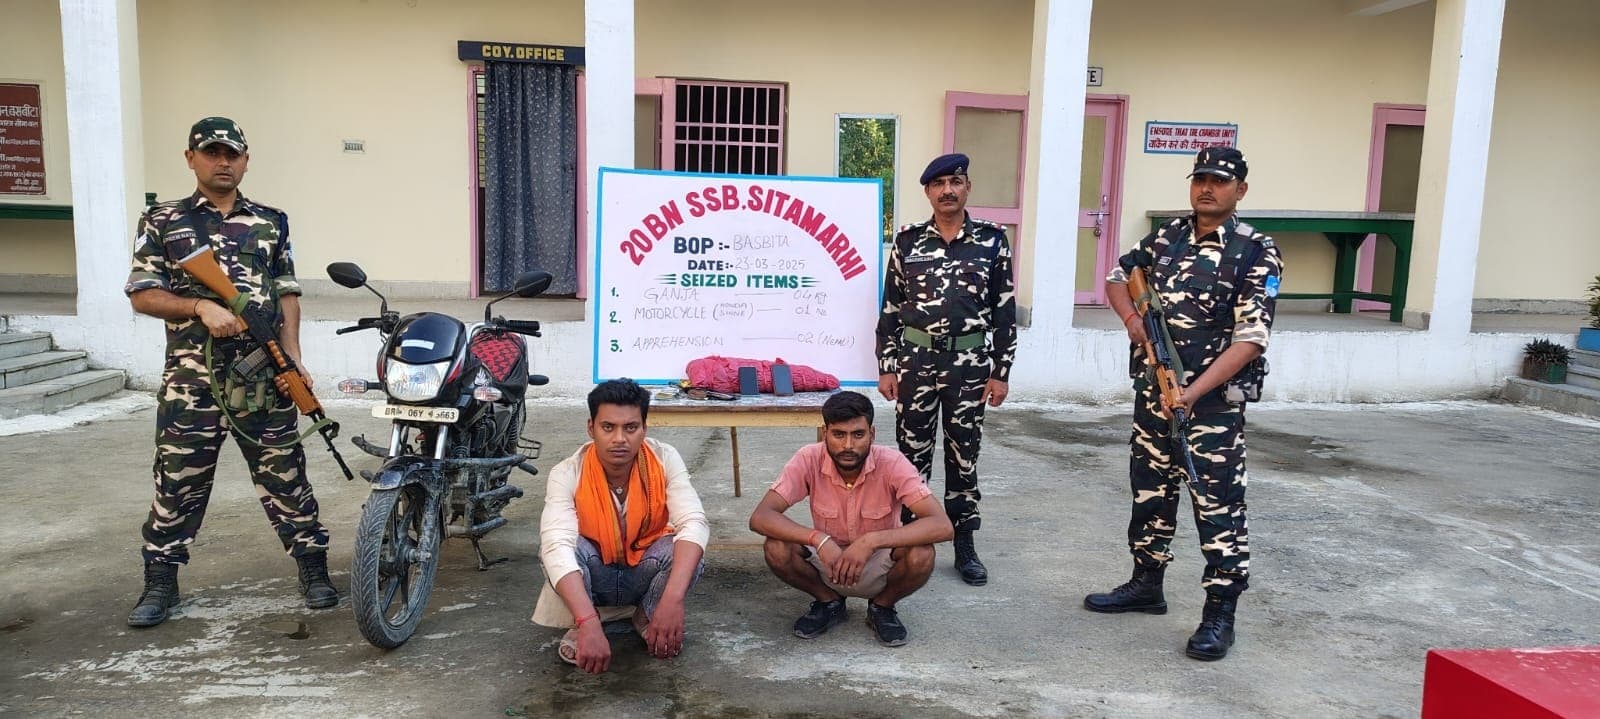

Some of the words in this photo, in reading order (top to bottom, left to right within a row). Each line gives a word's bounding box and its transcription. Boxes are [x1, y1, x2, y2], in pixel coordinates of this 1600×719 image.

[620, 229, 653, 266] 20
[642, 199, 684, 241] BN
[673, 236, 714, 255] BOP
[680, 273, 738, 288] SEIZED
[746, 275, 799, 289] ITEMS
[610, 286, 620, 298] 1.
[609, 310, 622, 323] 2.
[634, 304, 707, 321] MOTORCYCLE
[610, 339, 623, 353] 3.
[632, 335, 725, 352] APPREHENSION
